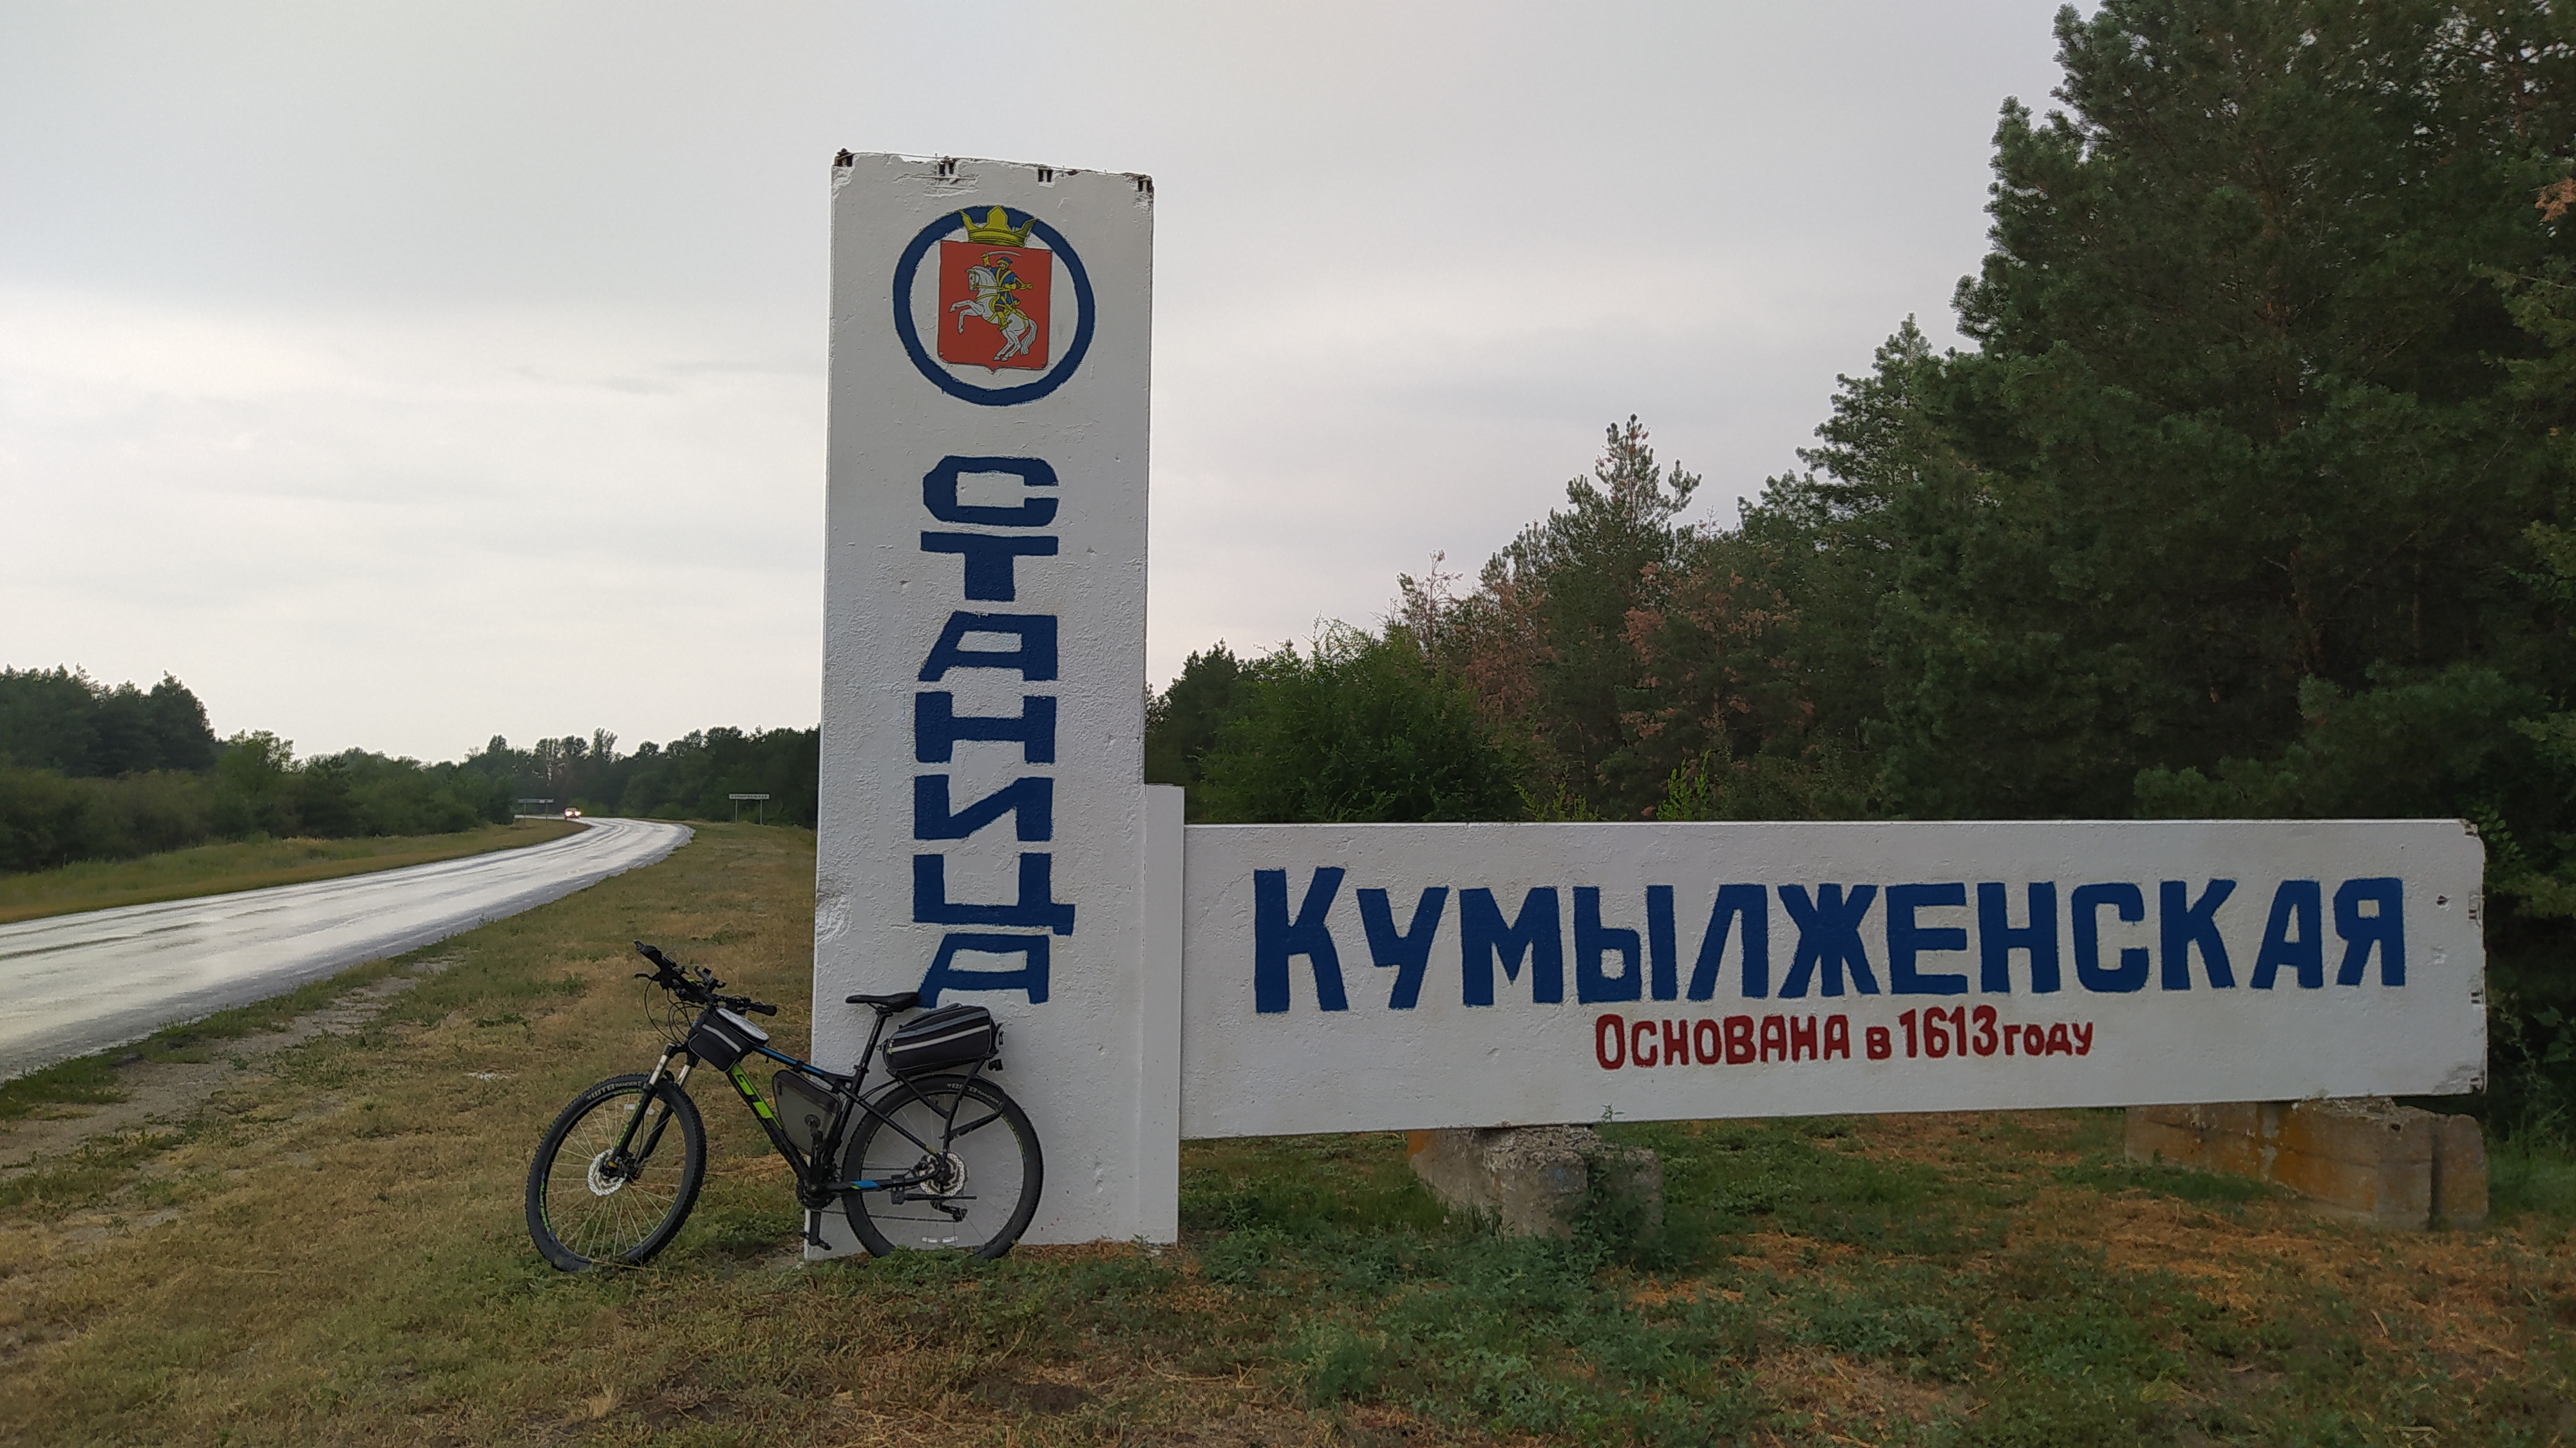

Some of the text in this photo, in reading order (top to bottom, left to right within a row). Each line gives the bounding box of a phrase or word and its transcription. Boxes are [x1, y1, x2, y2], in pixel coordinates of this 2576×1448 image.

[913, 455, 1075, 1009] СТАНИЦА
[1254, 866, 2405, 1013] КУМЫЛЖЕНСКАЯ
[1596, 1013, 1850, 1070] ОСНОВАНА
[1866, 1026, 1891, 1060] в
[1900, 1005, 1998, 1059] 1613
